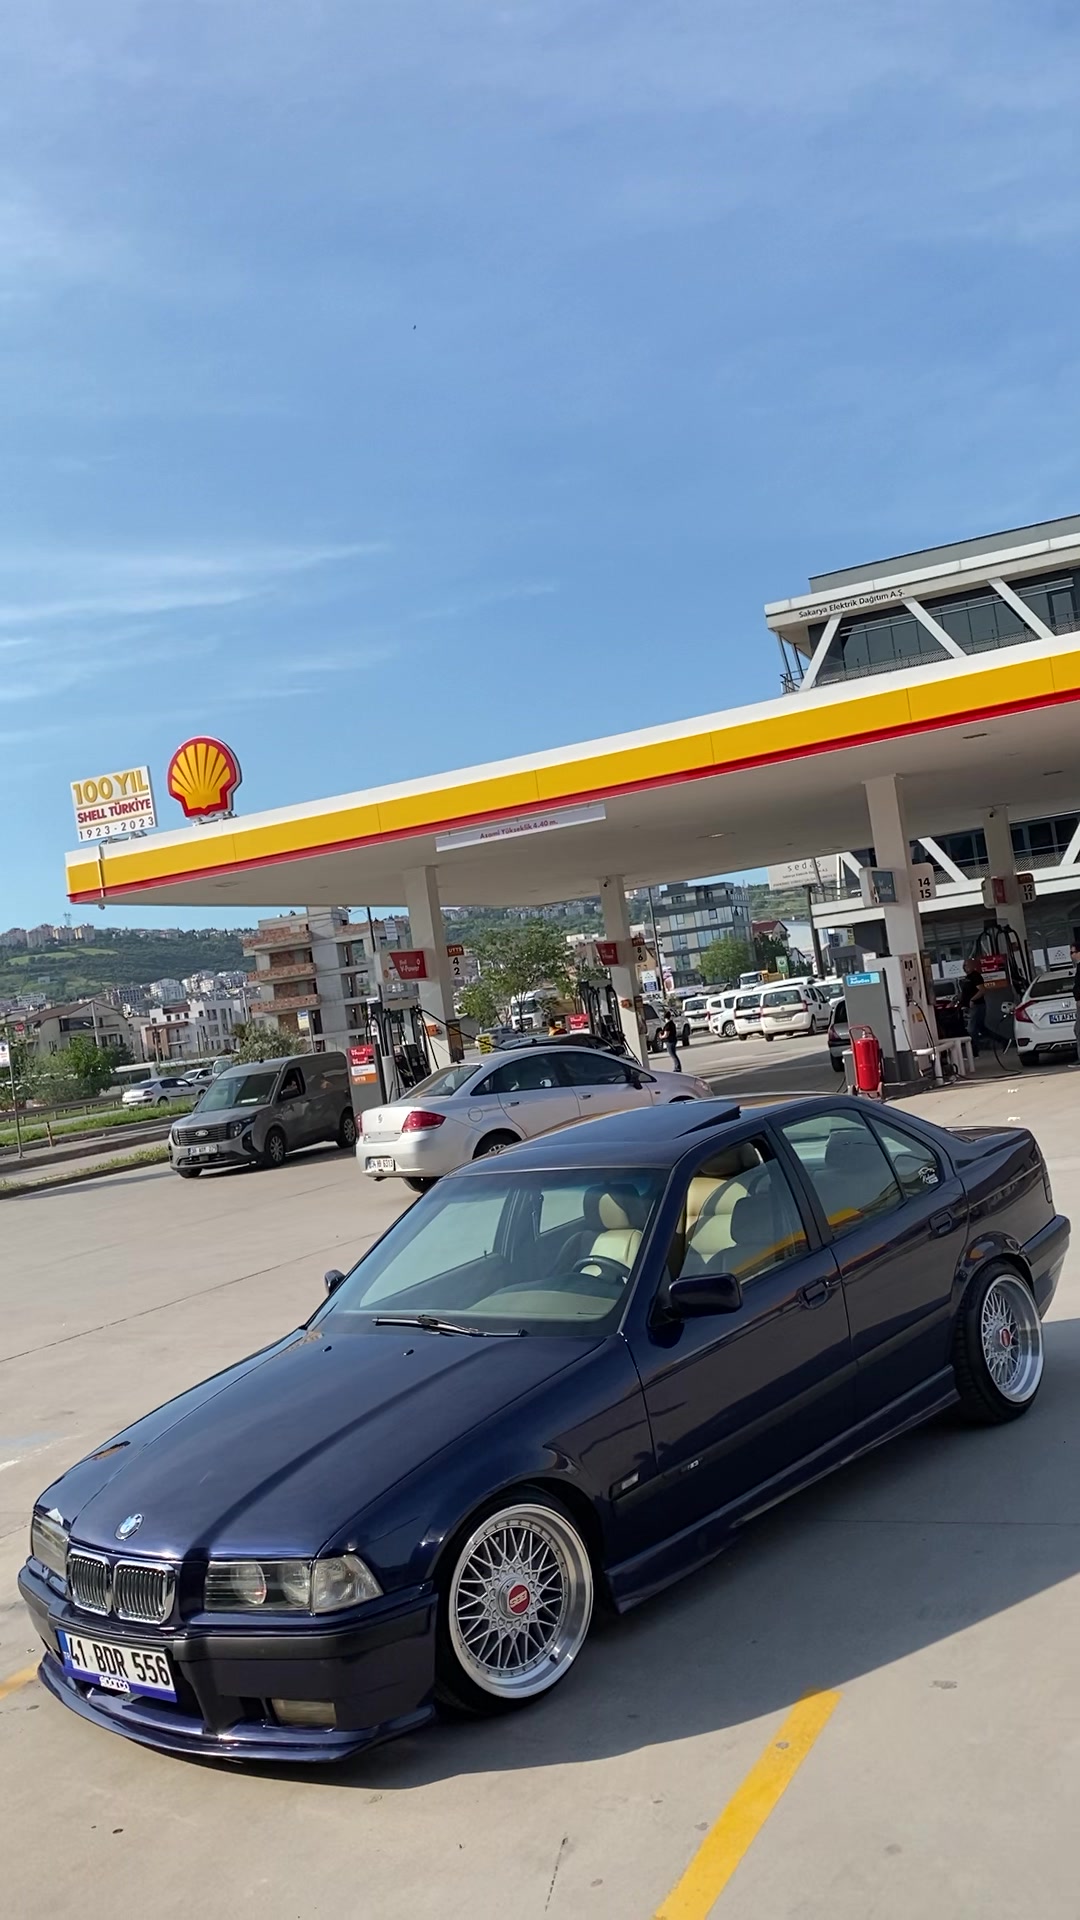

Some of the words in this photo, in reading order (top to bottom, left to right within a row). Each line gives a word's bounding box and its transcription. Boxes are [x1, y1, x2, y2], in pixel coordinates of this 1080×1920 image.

[798, 607, 828, 619] Sakarya
[829, 599, 858, 612] Elektrik
[859, 594, 889, 605] Dağıtım
[72, 776, 114, 806] 100
[112, 769, 149, 796] YIL
[77, 808, 107, 824] SHELL
[108, 797, 152, 817] TÜRKİYE
[501, 823, 533, 835] Yükseklik
[532, 820, 549, 829] 4.40
[917, 877, 931, 887] 14
[919, 888, 932, 899] 15
[1023, 884, 1033, 892] 12
[1024, 892, 1033, 900] 11
[452, 956, 459, 965] 4
[453, 966, 461, 975] 2
[69, 1637, 88, 1669] 41
[92, 1643, 129, 1679] BDR
[130, 1651, 171, 1687] 556
